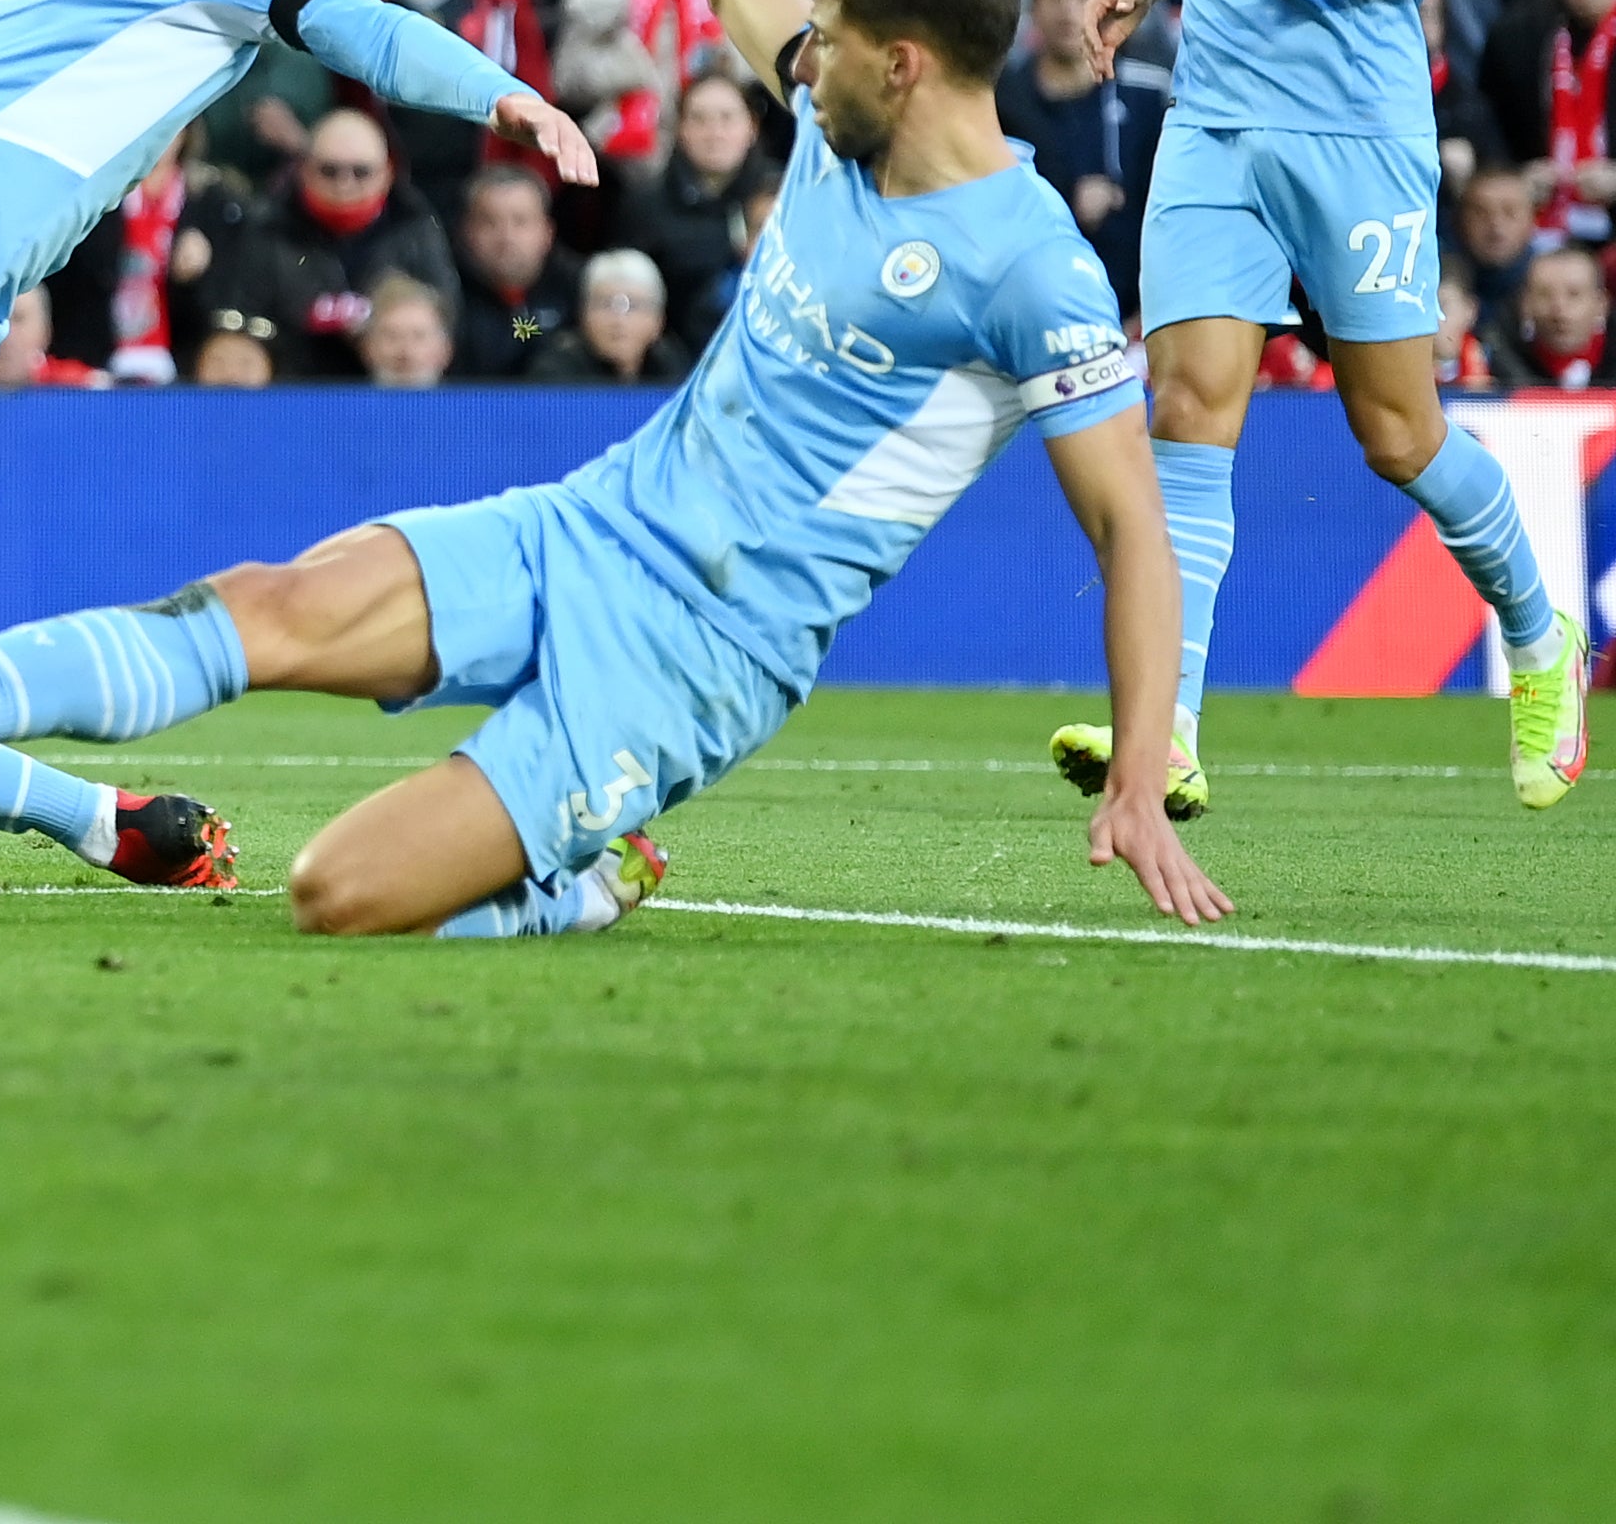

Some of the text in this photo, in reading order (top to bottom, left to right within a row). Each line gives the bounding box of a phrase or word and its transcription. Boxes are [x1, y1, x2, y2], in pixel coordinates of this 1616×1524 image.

[761, 198, 896, 374] TIHAD
[1348, 208, 1428, 294] 27
[1081, 359, 1128, 386] Cap
[570, 748, 653, 832] 3
